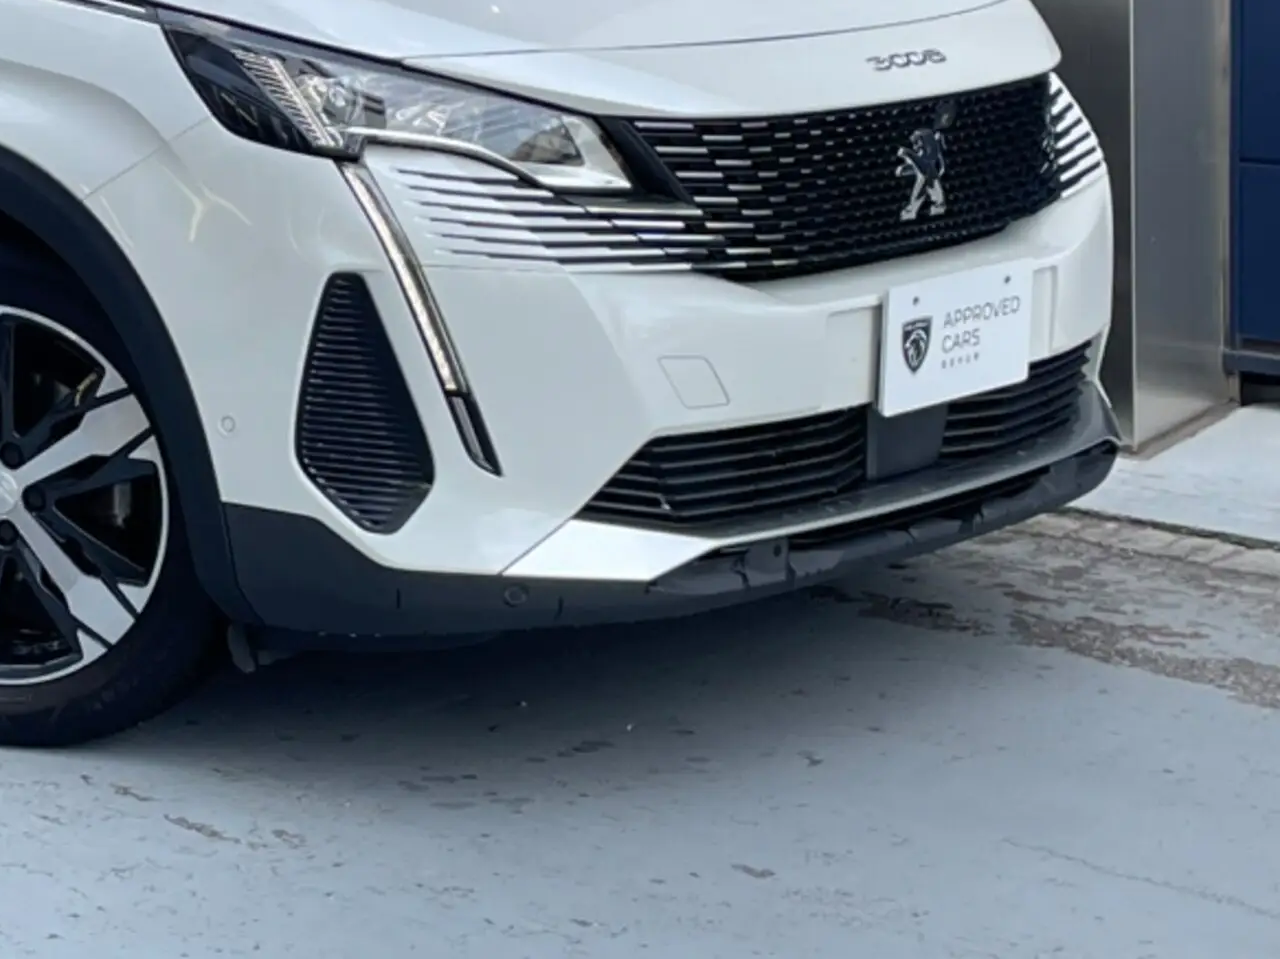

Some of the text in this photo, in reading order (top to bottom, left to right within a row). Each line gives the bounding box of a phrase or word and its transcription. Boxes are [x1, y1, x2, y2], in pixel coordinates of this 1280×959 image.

[865, 49, 947, 71] 3008
[942, 296, 1020, 328] APPROVED
[941, 328, 980, 353] CARS
